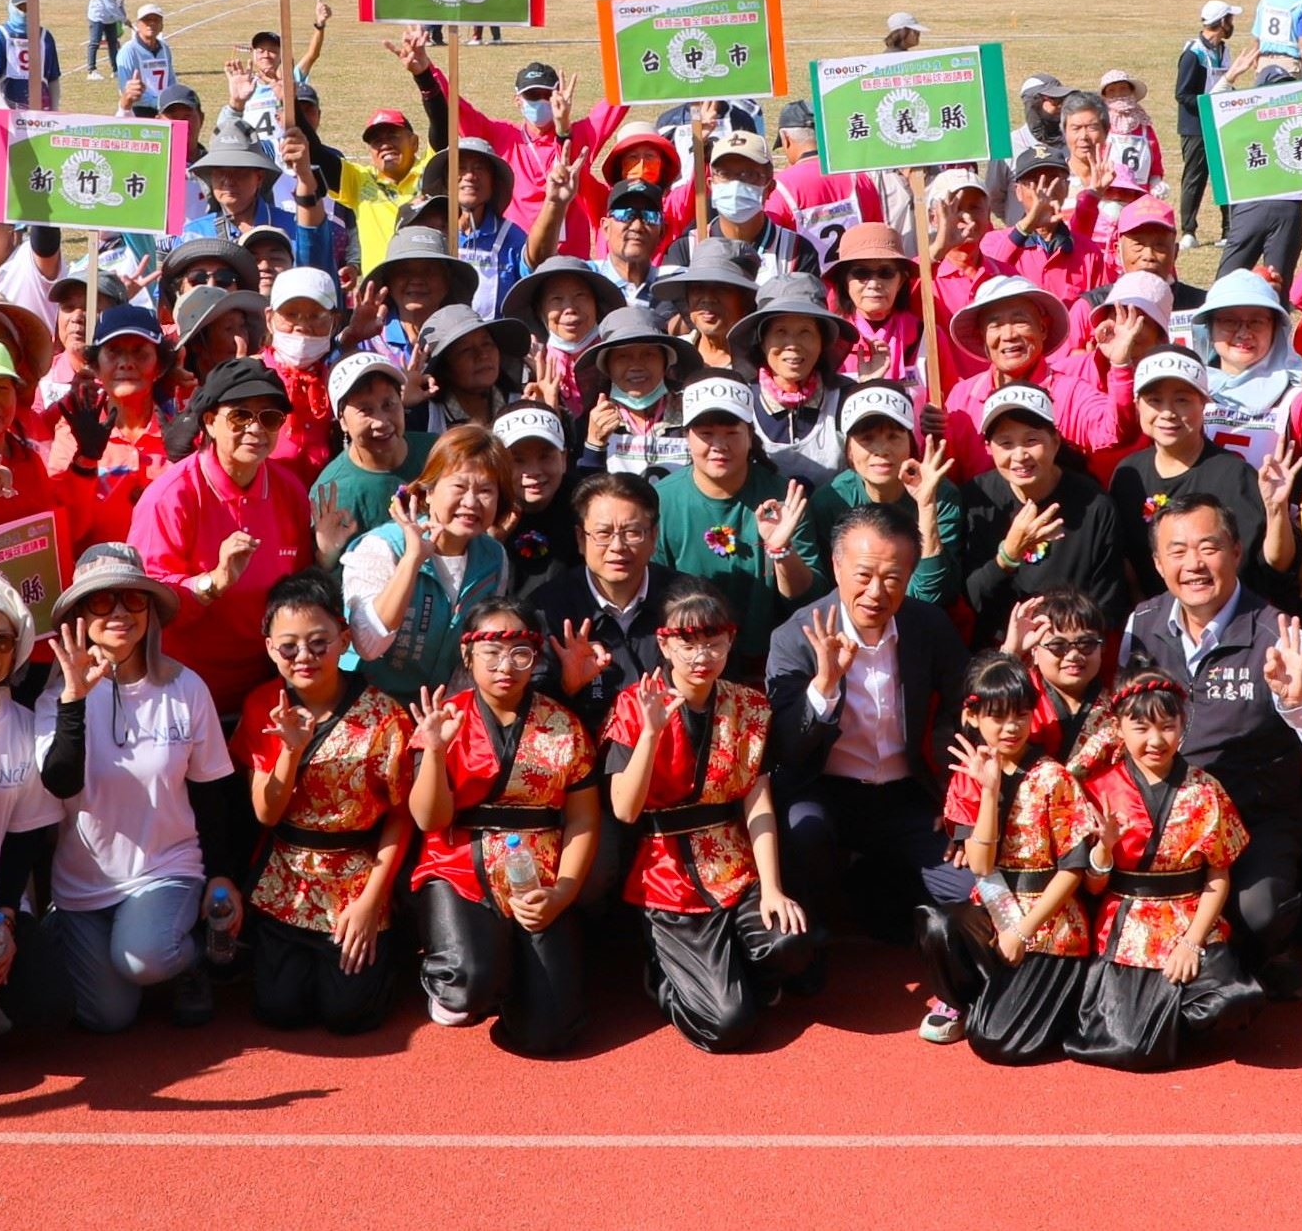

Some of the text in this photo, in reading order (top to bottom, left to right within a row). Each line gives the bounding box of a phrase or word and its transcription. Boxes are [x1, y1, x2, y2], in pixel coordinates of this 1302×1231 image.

[619, 5, 660, 15] CROQUET
[1268, 17, 1280, 36] 8
[641, 44, 749, 74] 台中市
[824, 64, 867, 76] CROQUET
[152, 70, 166, 91] 7
[1219, 95, 1262, 109] CROQUET
[16, 119, 59, 128] CROQUET
[256, 111, 276, 136] 4
[848, 102, 967, 142] 嘉義縣
[1122, 147, 1140, 173] 6
[30, 165, 146, 199] 新竹市
[819, 224, 847, 264] 2
[1138, 355, 1206, 380] SPORT
[685, 386, 752, 407] SPORT
[843, 393, 913, 421] SPORT
[497, 413, 563, 436] SPORT
[21, 573, 45, 605] 縣
[1206, 681, 1254, 701] 江志明
